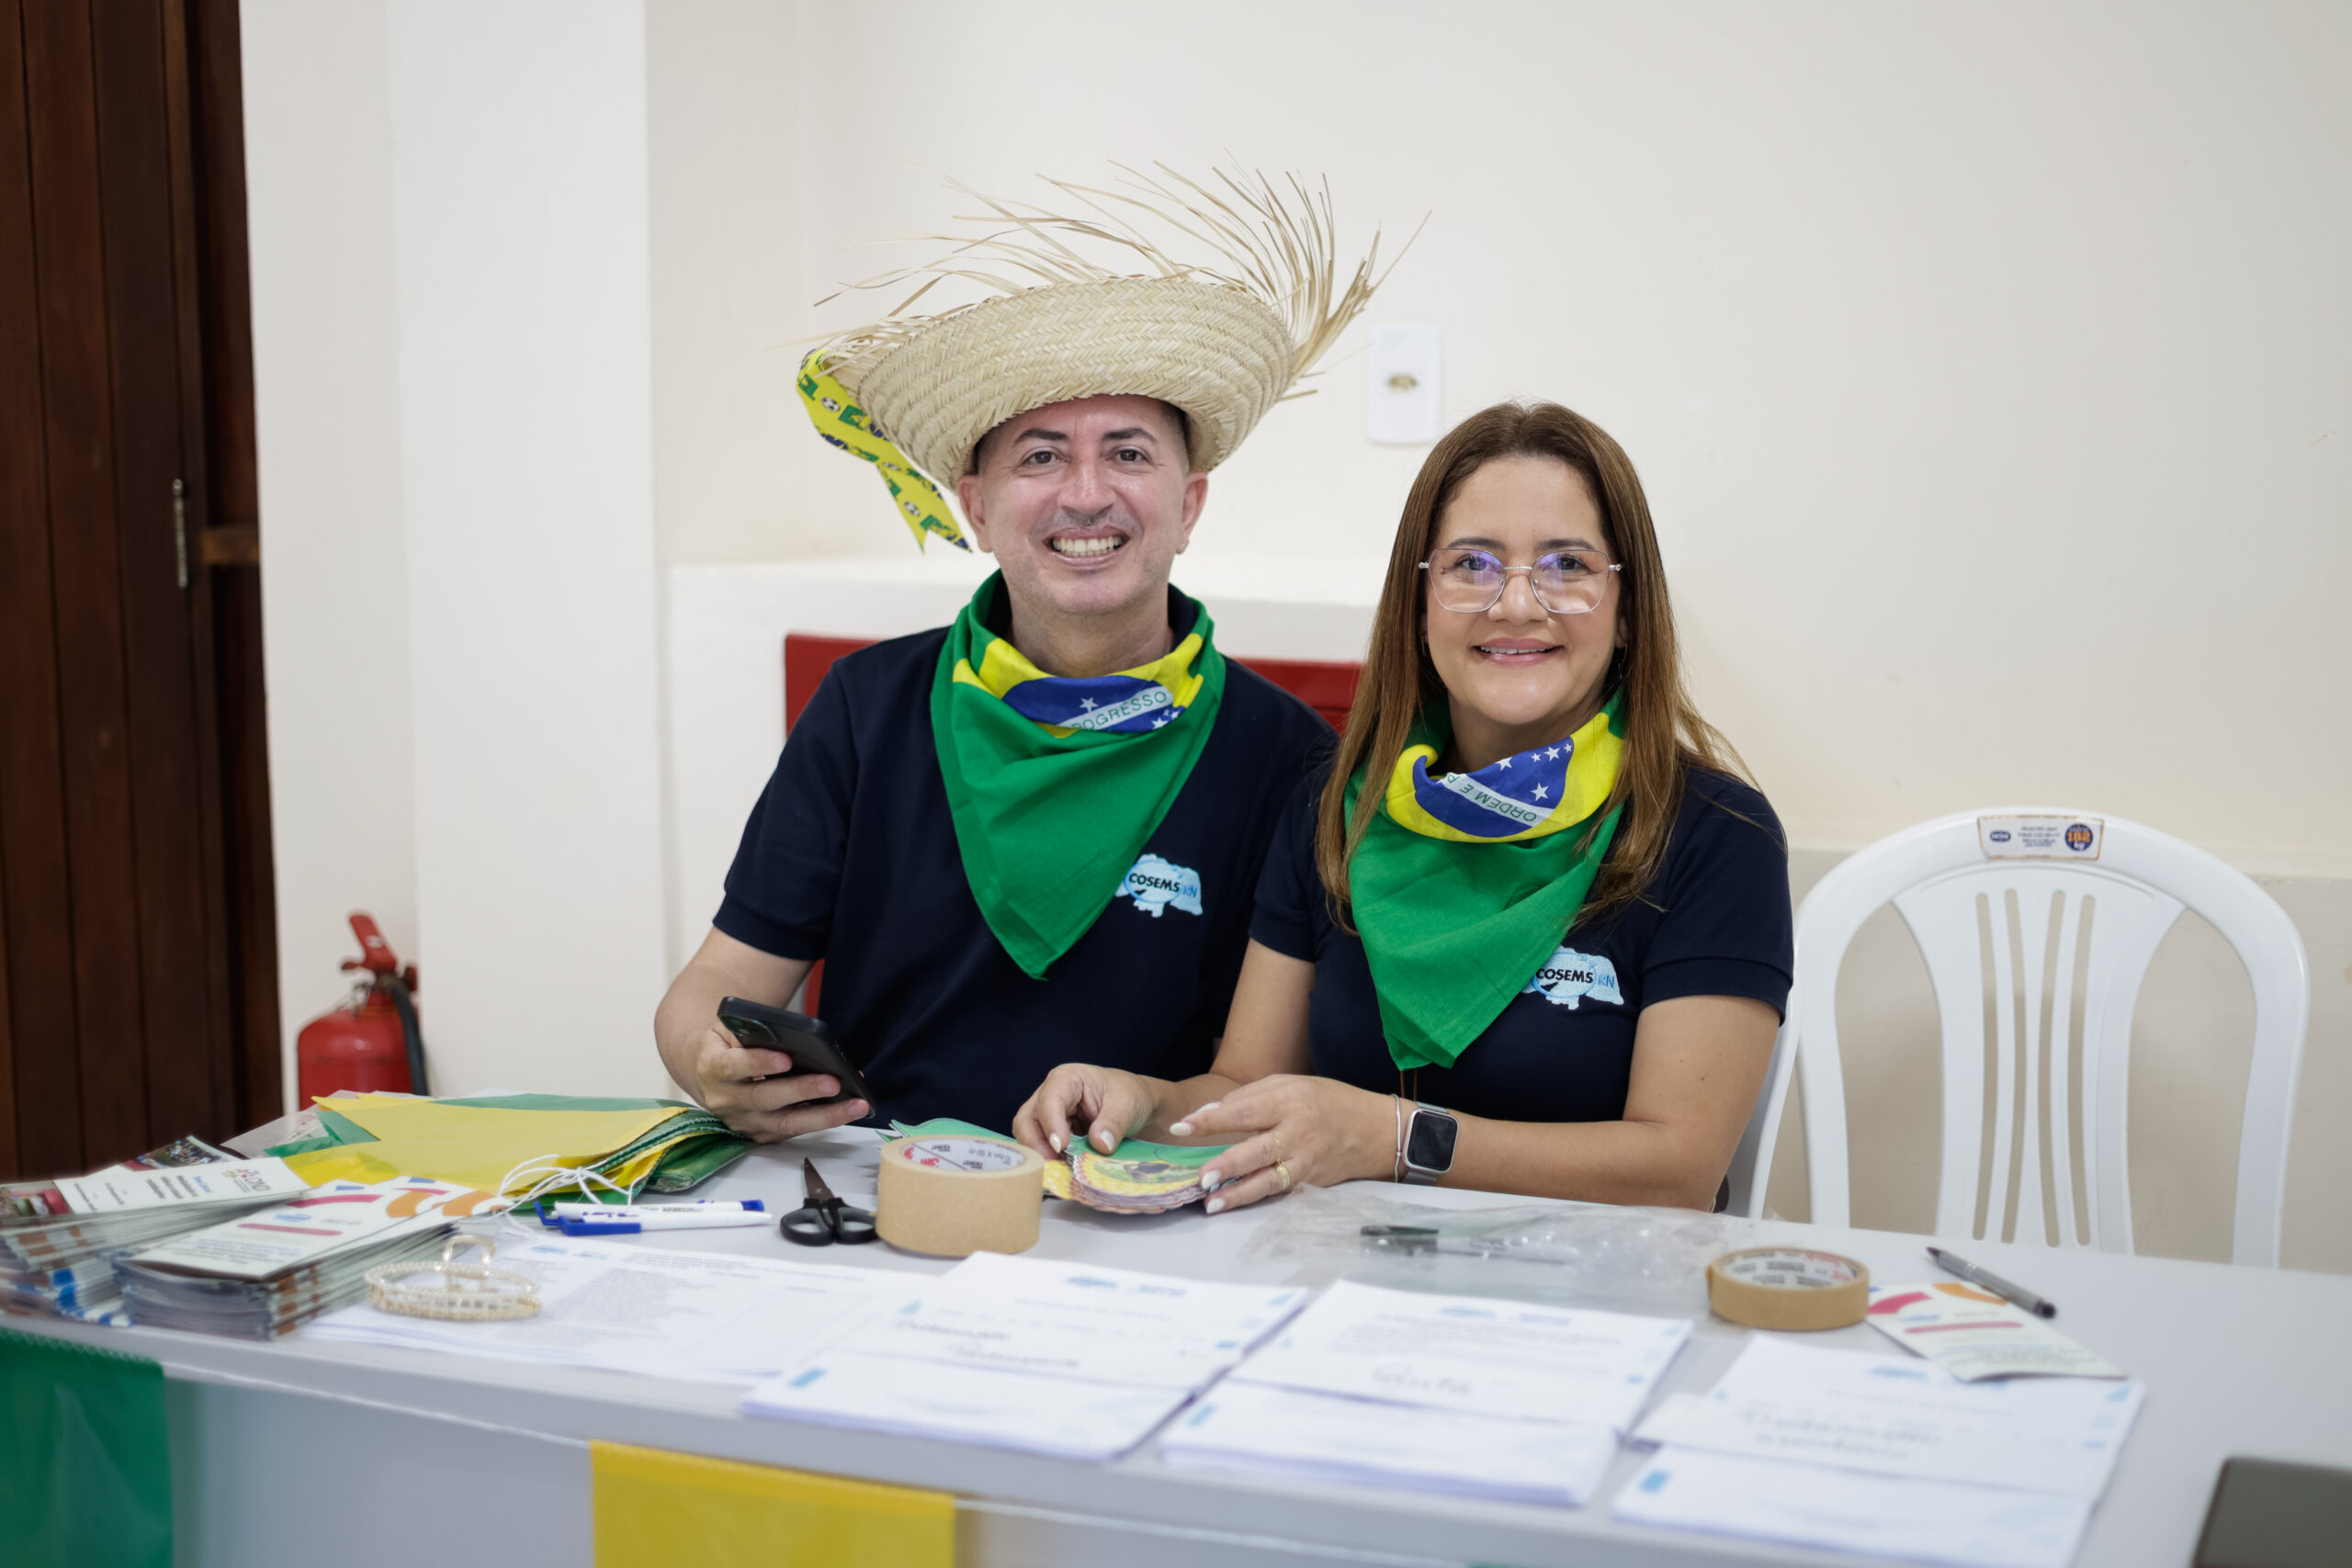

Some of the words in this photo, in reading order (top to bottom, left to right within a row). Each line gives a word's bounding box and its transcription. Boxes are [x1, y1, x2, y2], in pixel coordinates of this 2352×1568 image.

[1459, 783, 1475, 794] E
[1475, 792, 1537, 822] ORDEM
[1128, 873, 1181, 893] COSEMS
[1536, 967, 1594, 984] COSEMS
